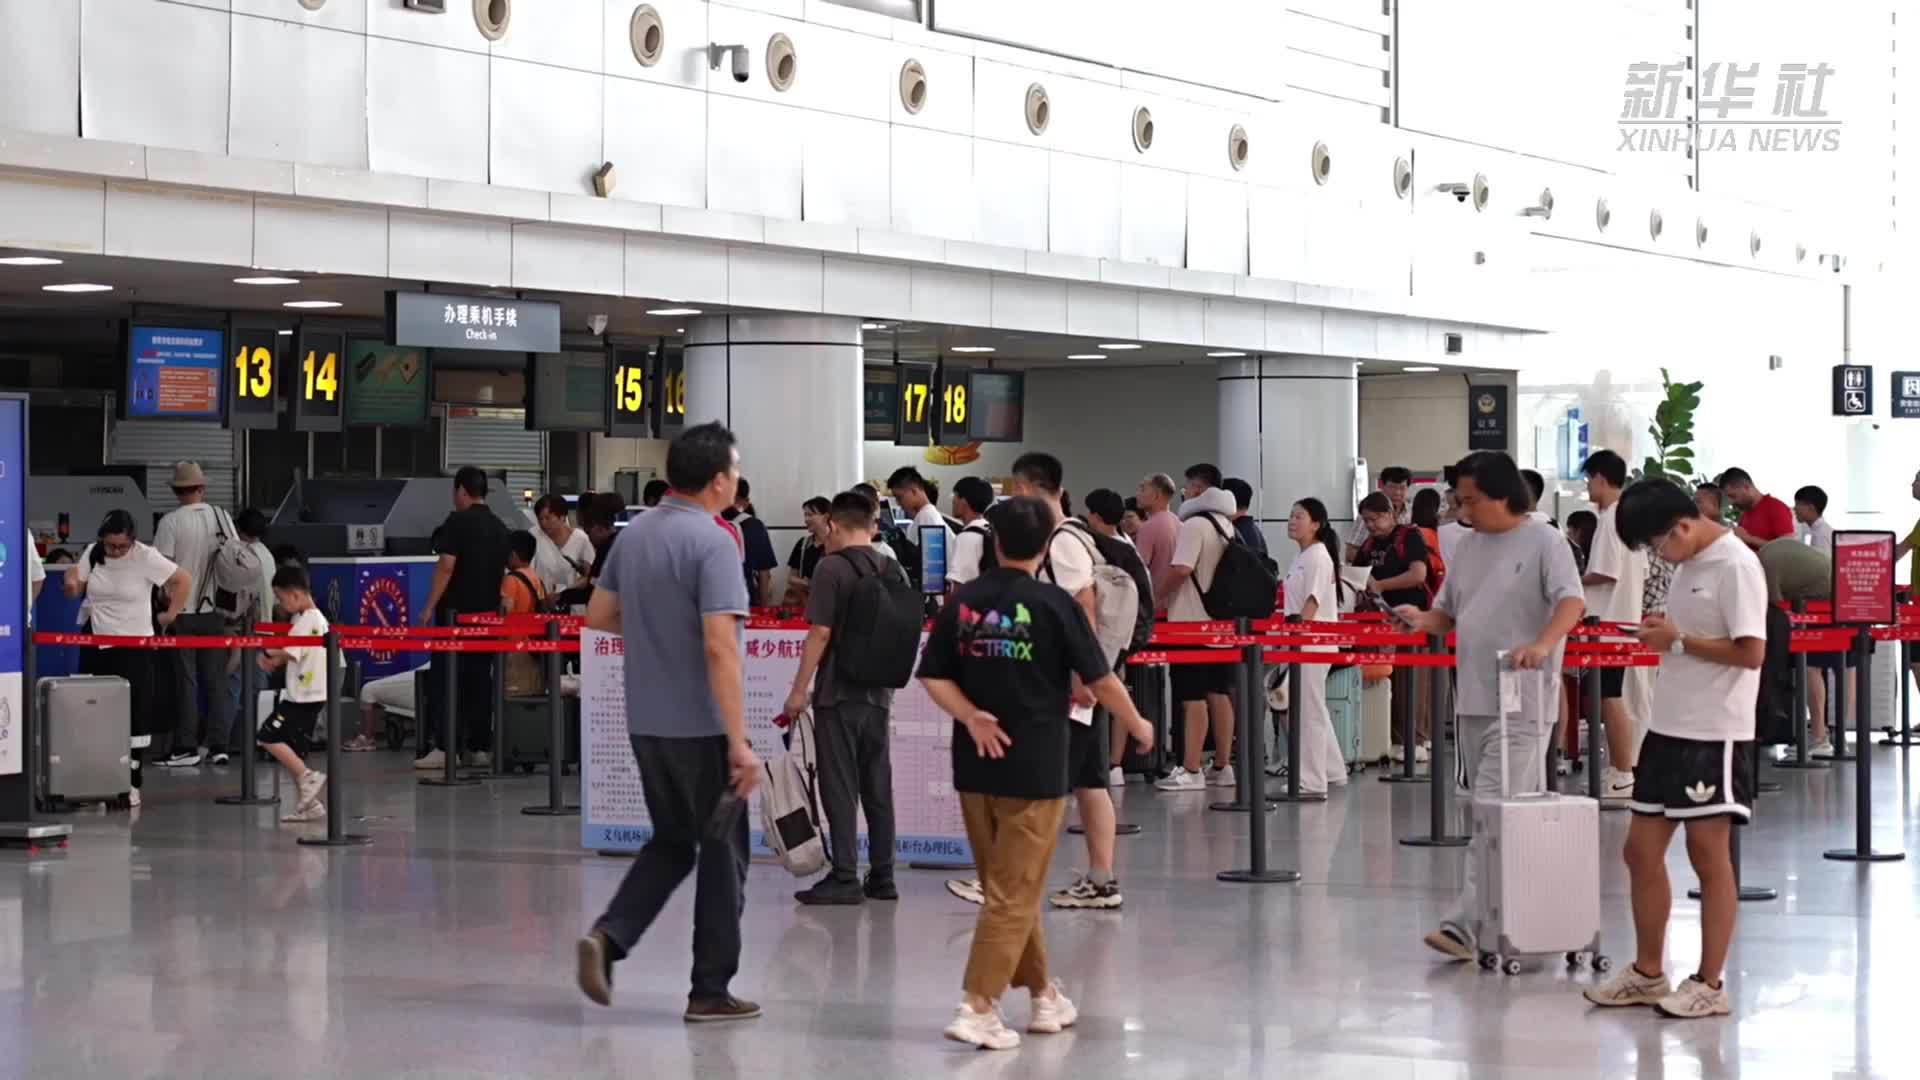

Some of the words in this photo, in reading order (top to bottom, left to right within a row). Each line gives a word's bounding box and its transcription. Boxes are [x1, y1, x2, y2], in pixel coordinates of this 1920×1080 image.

[444, 303, 518, 328] 办理乘机手续
[465, 328, 498, 341] Check-in
[235, 346, 272, 398] 13
[303, 350, 338, 401] 14
[614, 365, 643, 412] 15
[904, 383, 928, 423] 17
[944, 384, 966, 424] 18
